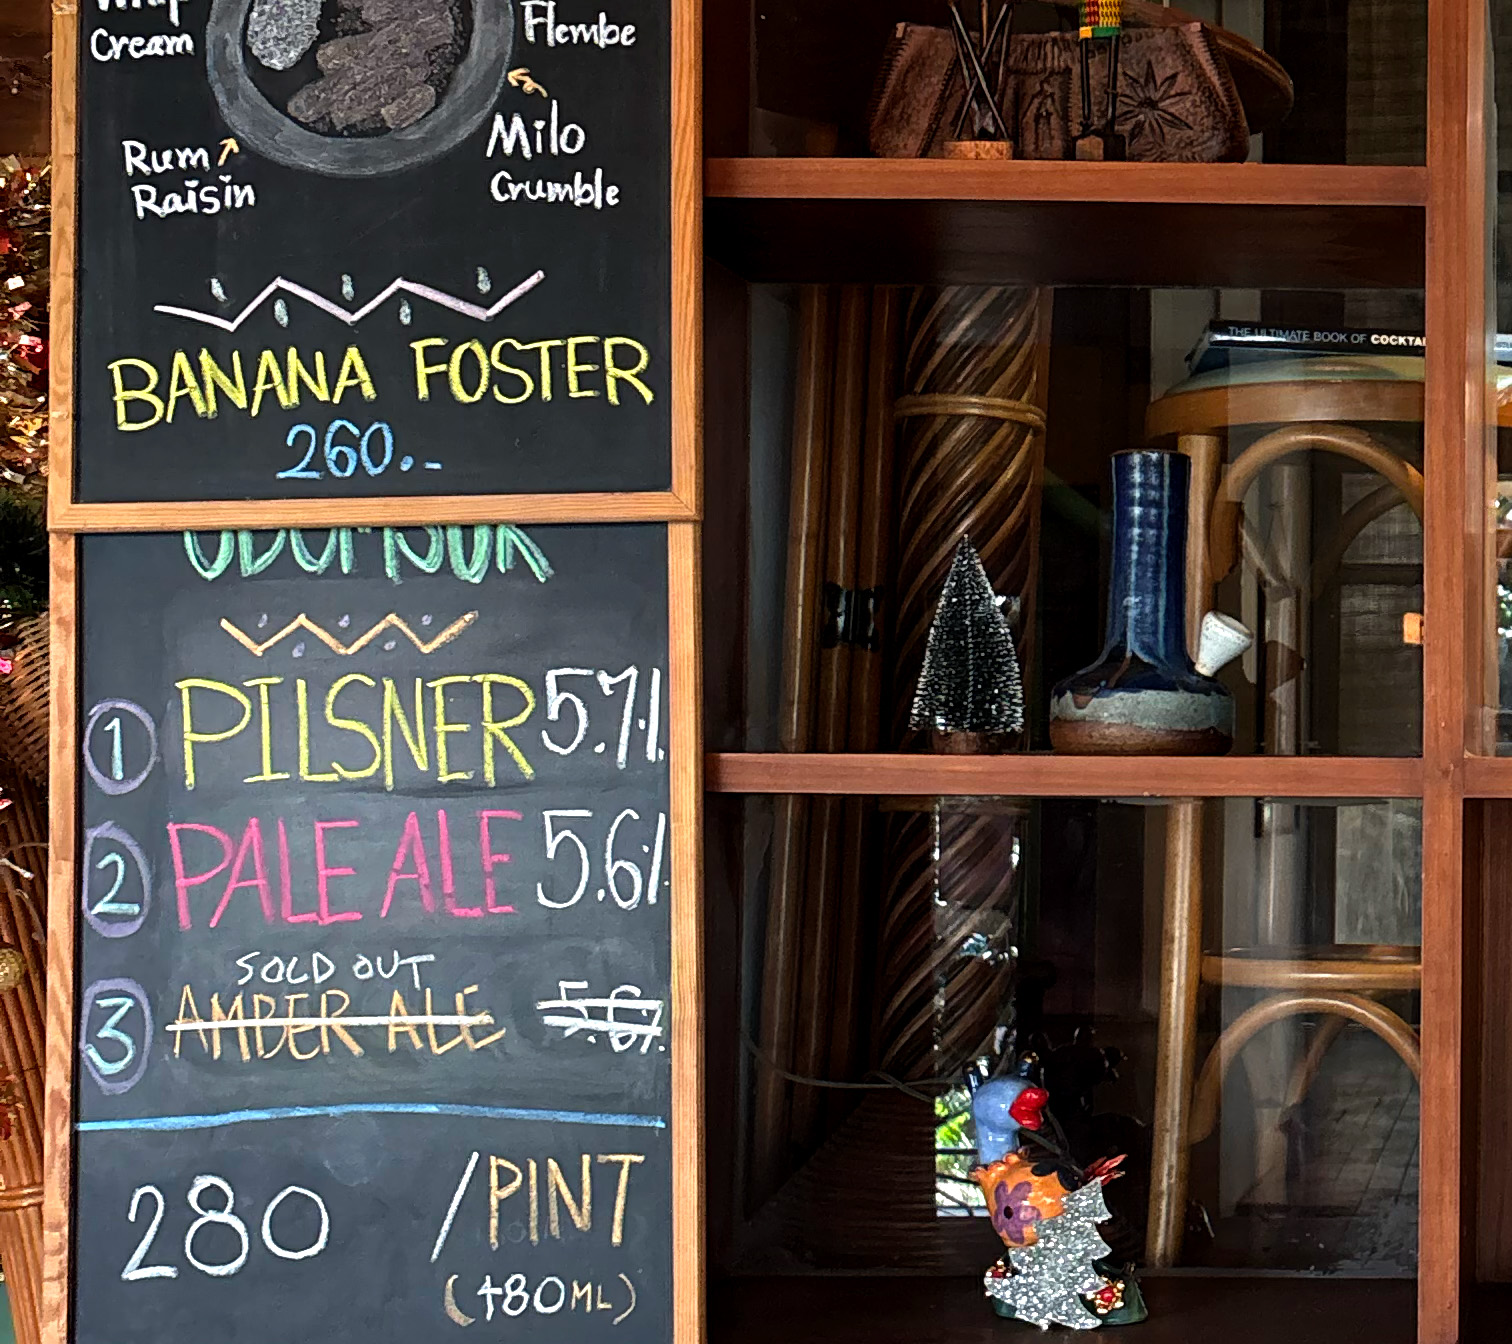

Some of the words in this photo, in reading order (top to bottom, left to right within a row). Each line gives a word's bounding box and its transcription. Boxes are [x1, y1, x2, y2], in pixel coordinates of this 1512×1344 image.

[91, 28, 194, 62] Cream
[487, 100, 586, 157] Milo
[122, 140, 210, 176] Rum
[131, 175, 256, 219] Raisin
[490, 167, 621, 210] Crumble
[1313, 330, 1349, 343] BOOK
[1350, 333, 1368, 344] OF
[1371, 333, 1427, 347] COCKTAI
[107, 346, 378, 432] BANANA
[410, 335, 655, 407] FOSTER
[102, 717, 125, 780] 1
[175, 674, 536, 791] PILSNER
[91, 853, 141, 916] 2
[167, 817, 364, 931] PALE
[380, 810, 524, 920] ALE
[236, 951, 335, 985] SOLD
[352, 951, 435, 989] OUT
[85, 998, 136, 1076] 3
[172, 985, 365, 1061] AMBER
[388, 985, 506, 1057] ALE
[120, 1174, 330, 1282] 280
